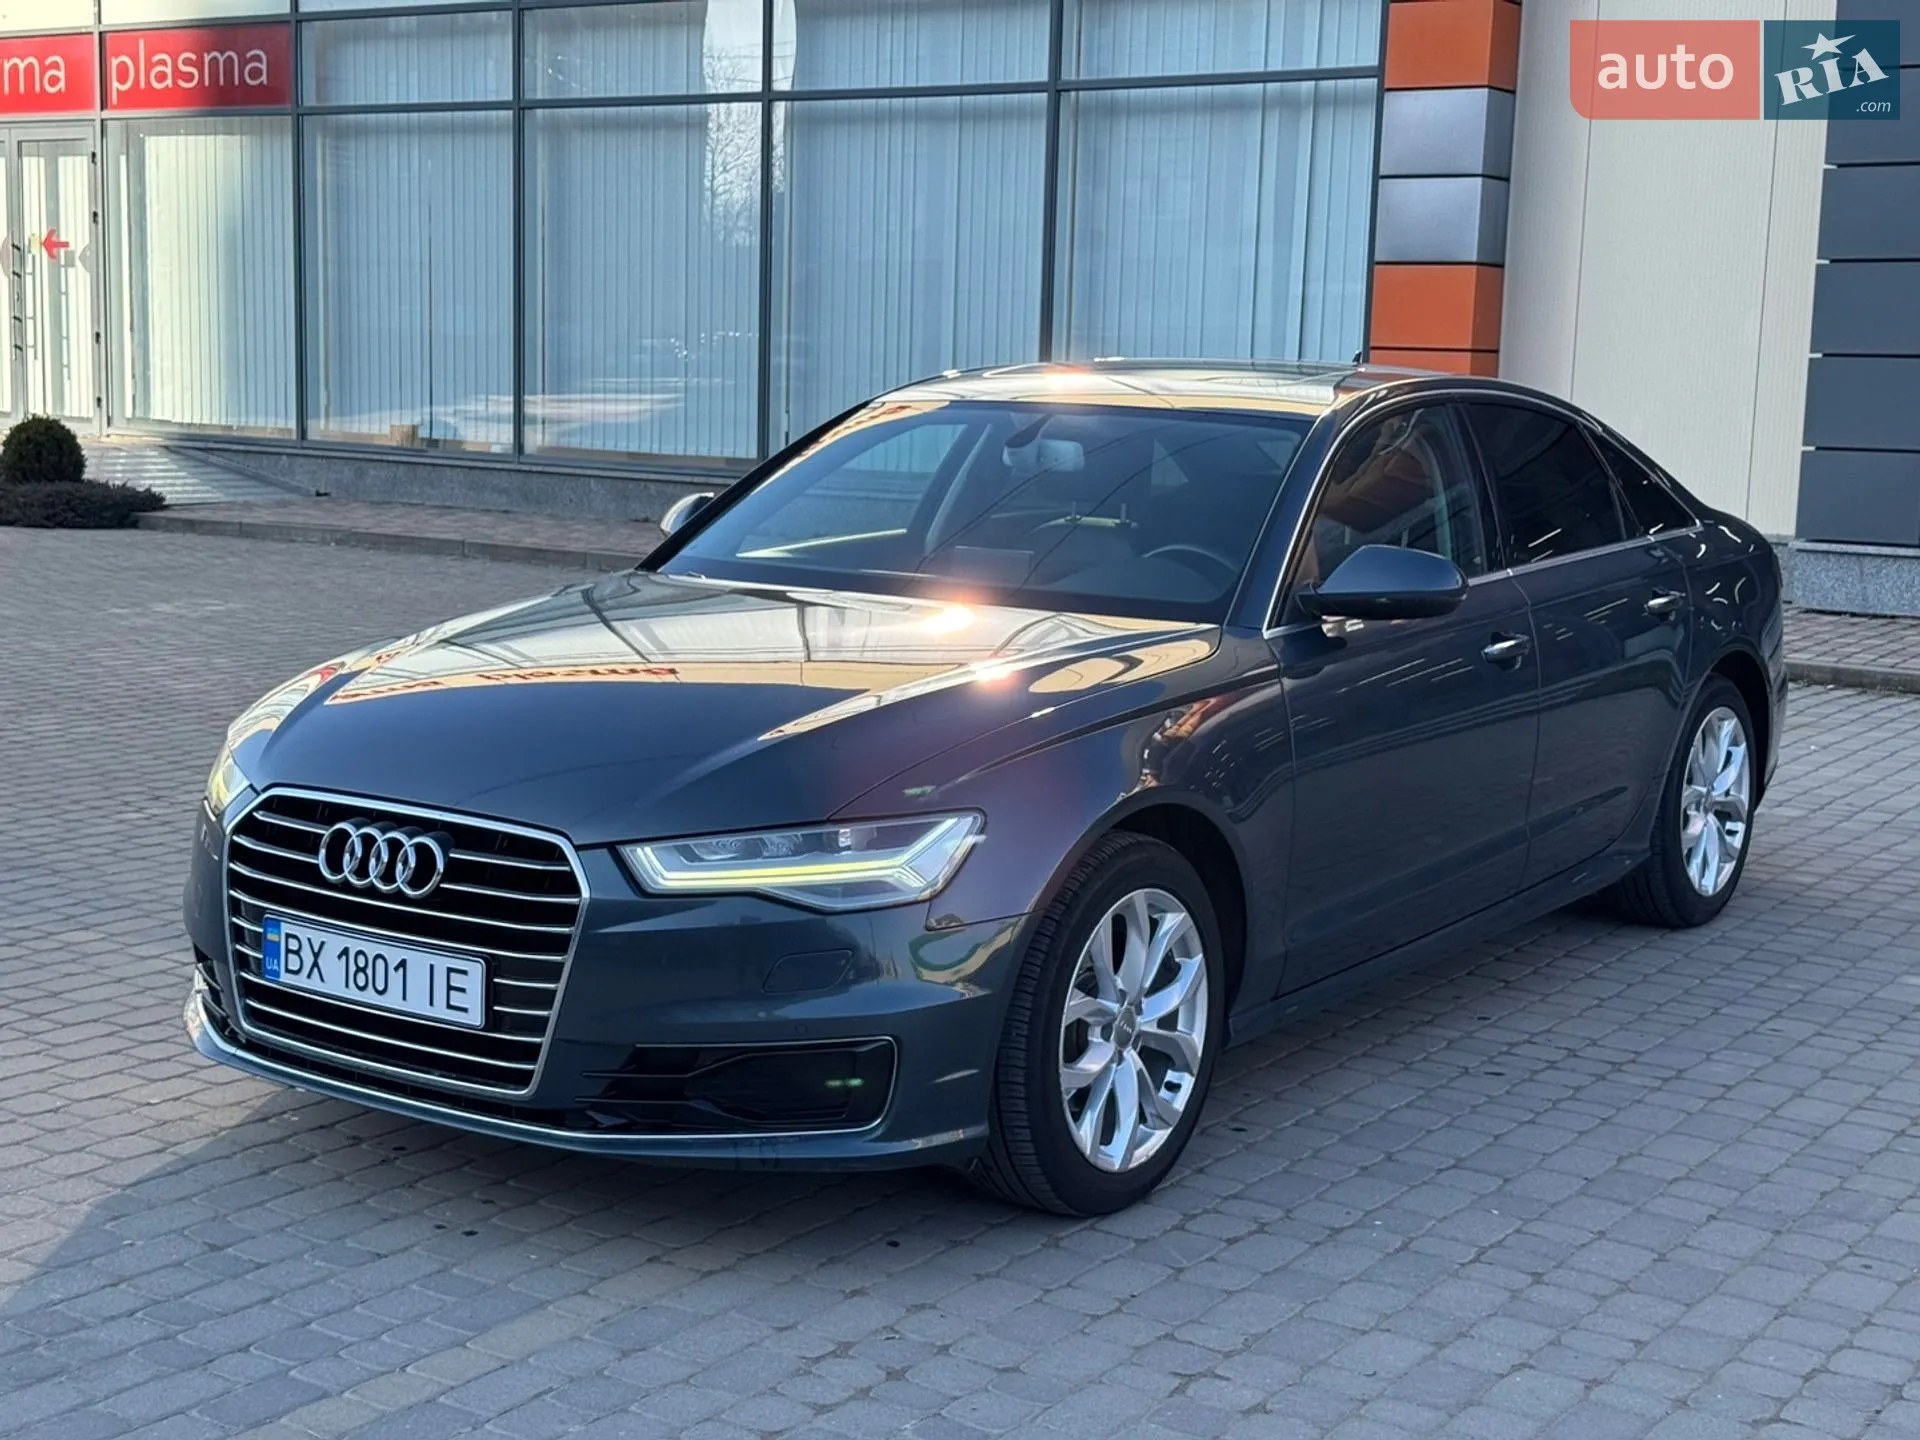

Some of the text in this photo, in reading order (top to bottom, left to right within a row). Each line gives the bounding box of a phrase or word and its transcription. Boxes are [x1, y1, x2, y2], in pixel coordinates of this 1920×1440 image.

[0, 55, 66, 96] ma
[110, 38, 269, 106] plasma
[265, 955, 280, 973] UA
[284, 931, 469, 1014] BX 1801 IE
